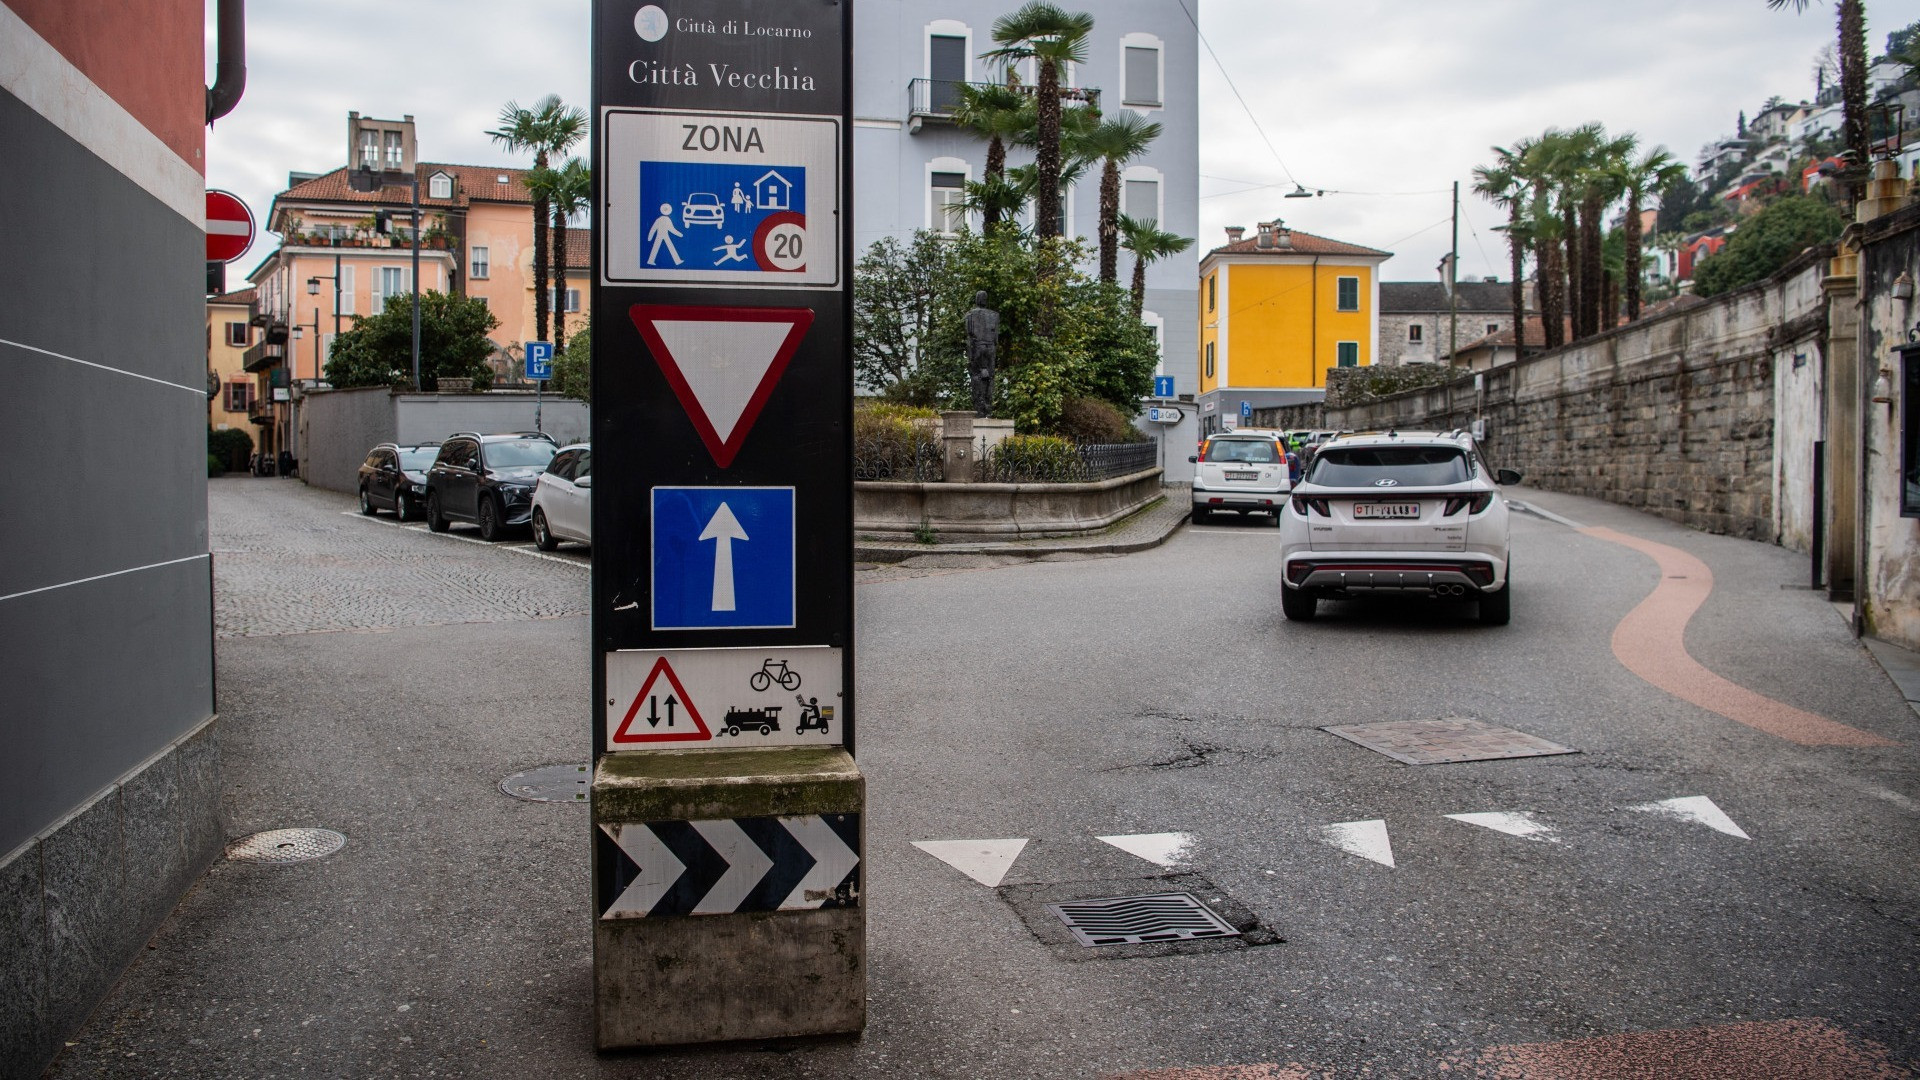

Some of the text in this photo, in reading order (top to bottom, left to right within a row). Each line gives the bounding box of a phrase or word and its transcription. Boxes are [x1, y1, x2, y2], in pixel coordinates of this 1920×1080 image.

[676, 18, 812, 38] Città di Locarno
[628, 59, 816, 91] Città Vecchia
[682, 124, 765, 153] ZONA
[773, 233, 803, 259] 20
[533, 345, 545, 362] P
